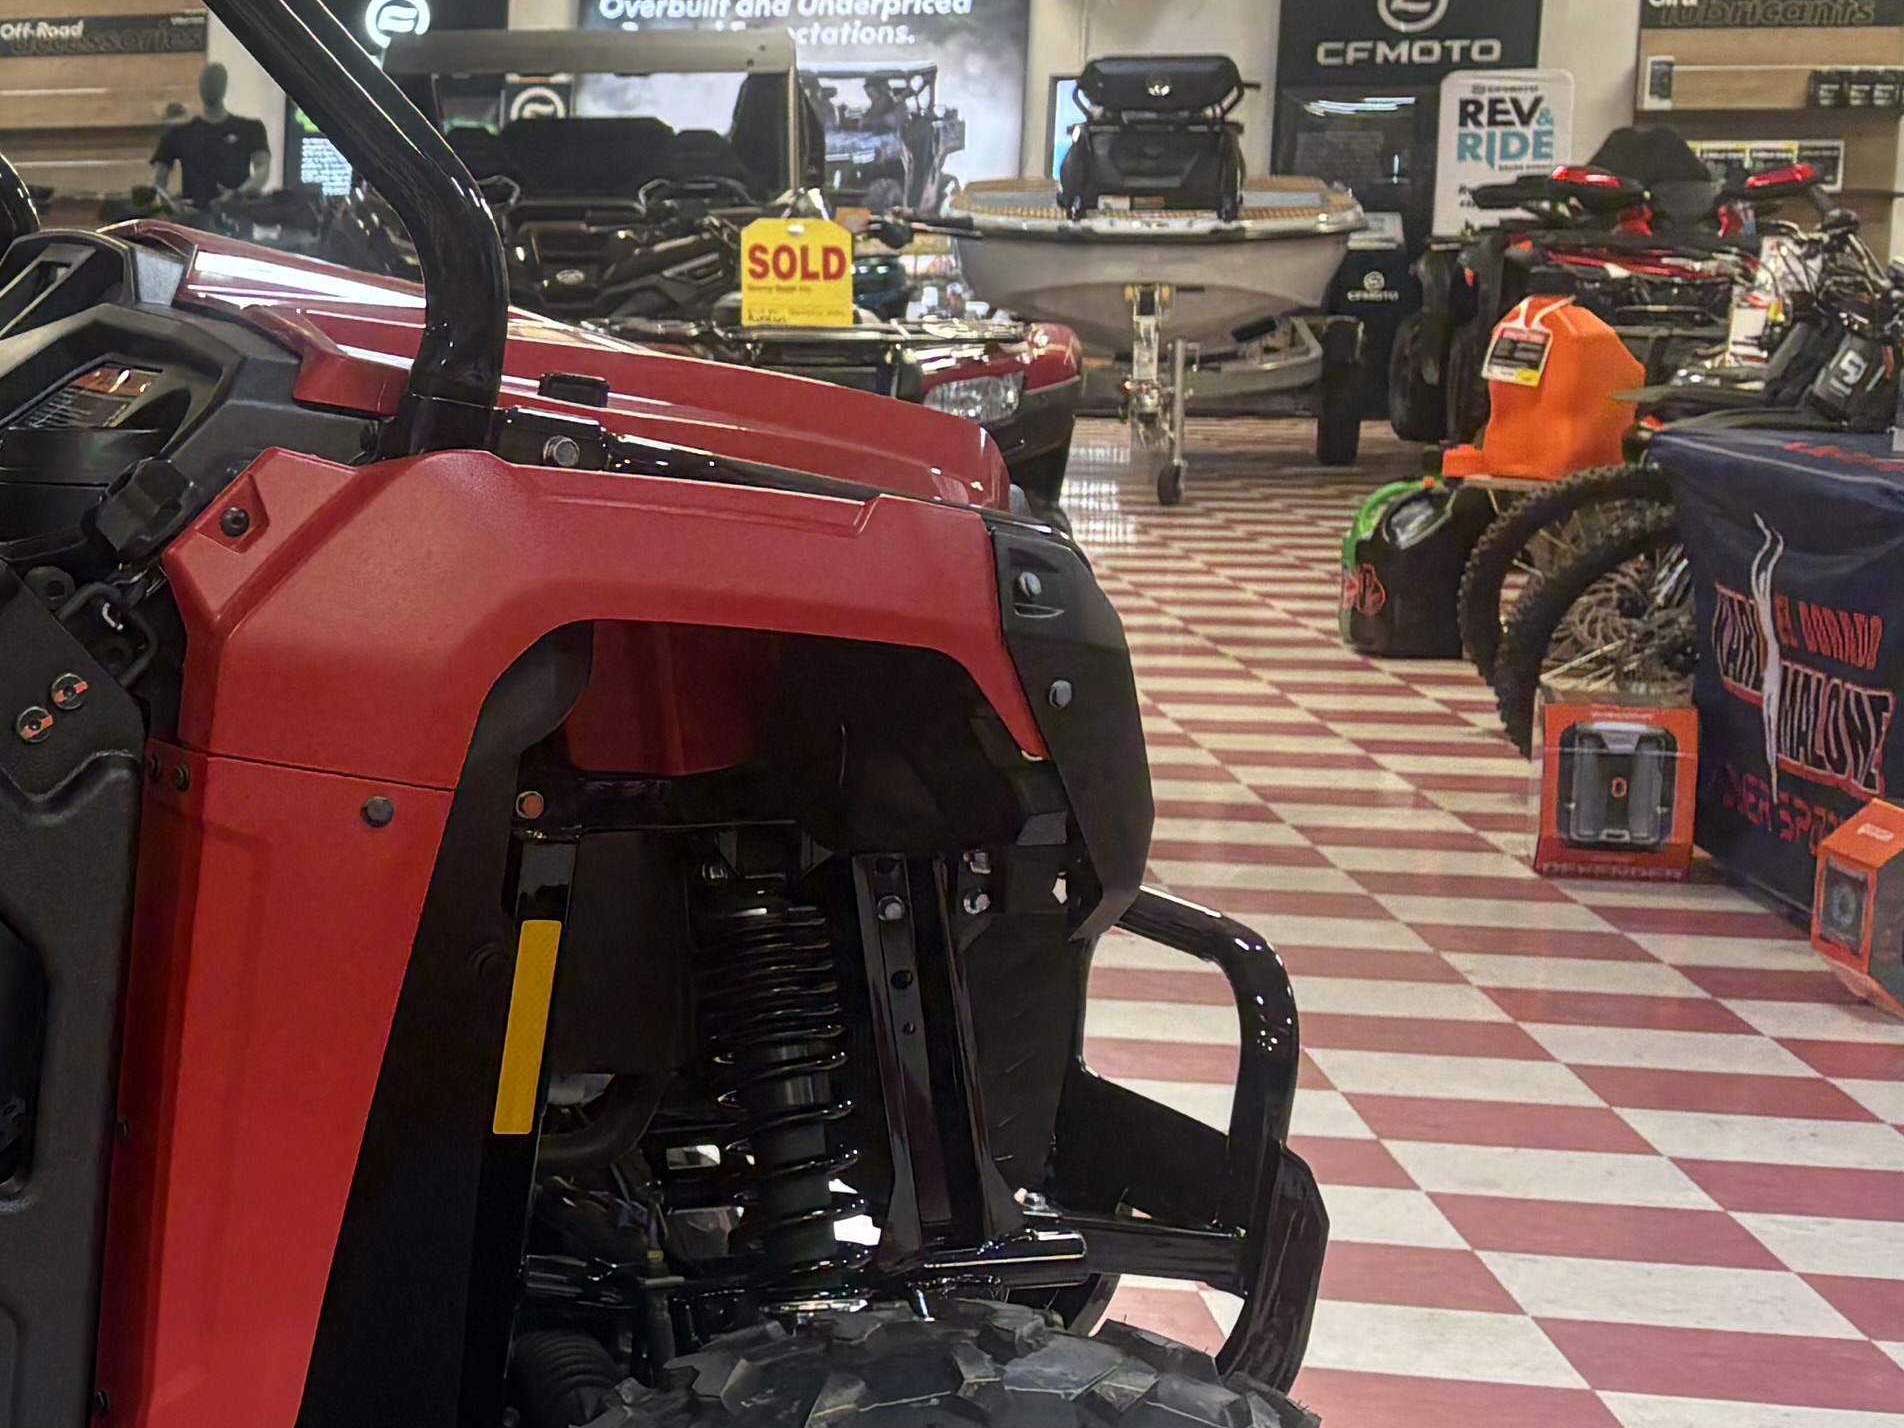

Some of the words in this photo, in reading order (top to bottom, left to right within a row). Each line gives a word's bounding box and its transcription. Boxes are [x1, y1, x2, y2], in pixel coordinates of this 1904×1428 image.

[0, 20, 84, 39] Off-Road
[1316, 38, 1502, 67] CFMOTO
[1457, 128, 1554, 169] RIDE
[748, 243, 847, 282] SOLD
